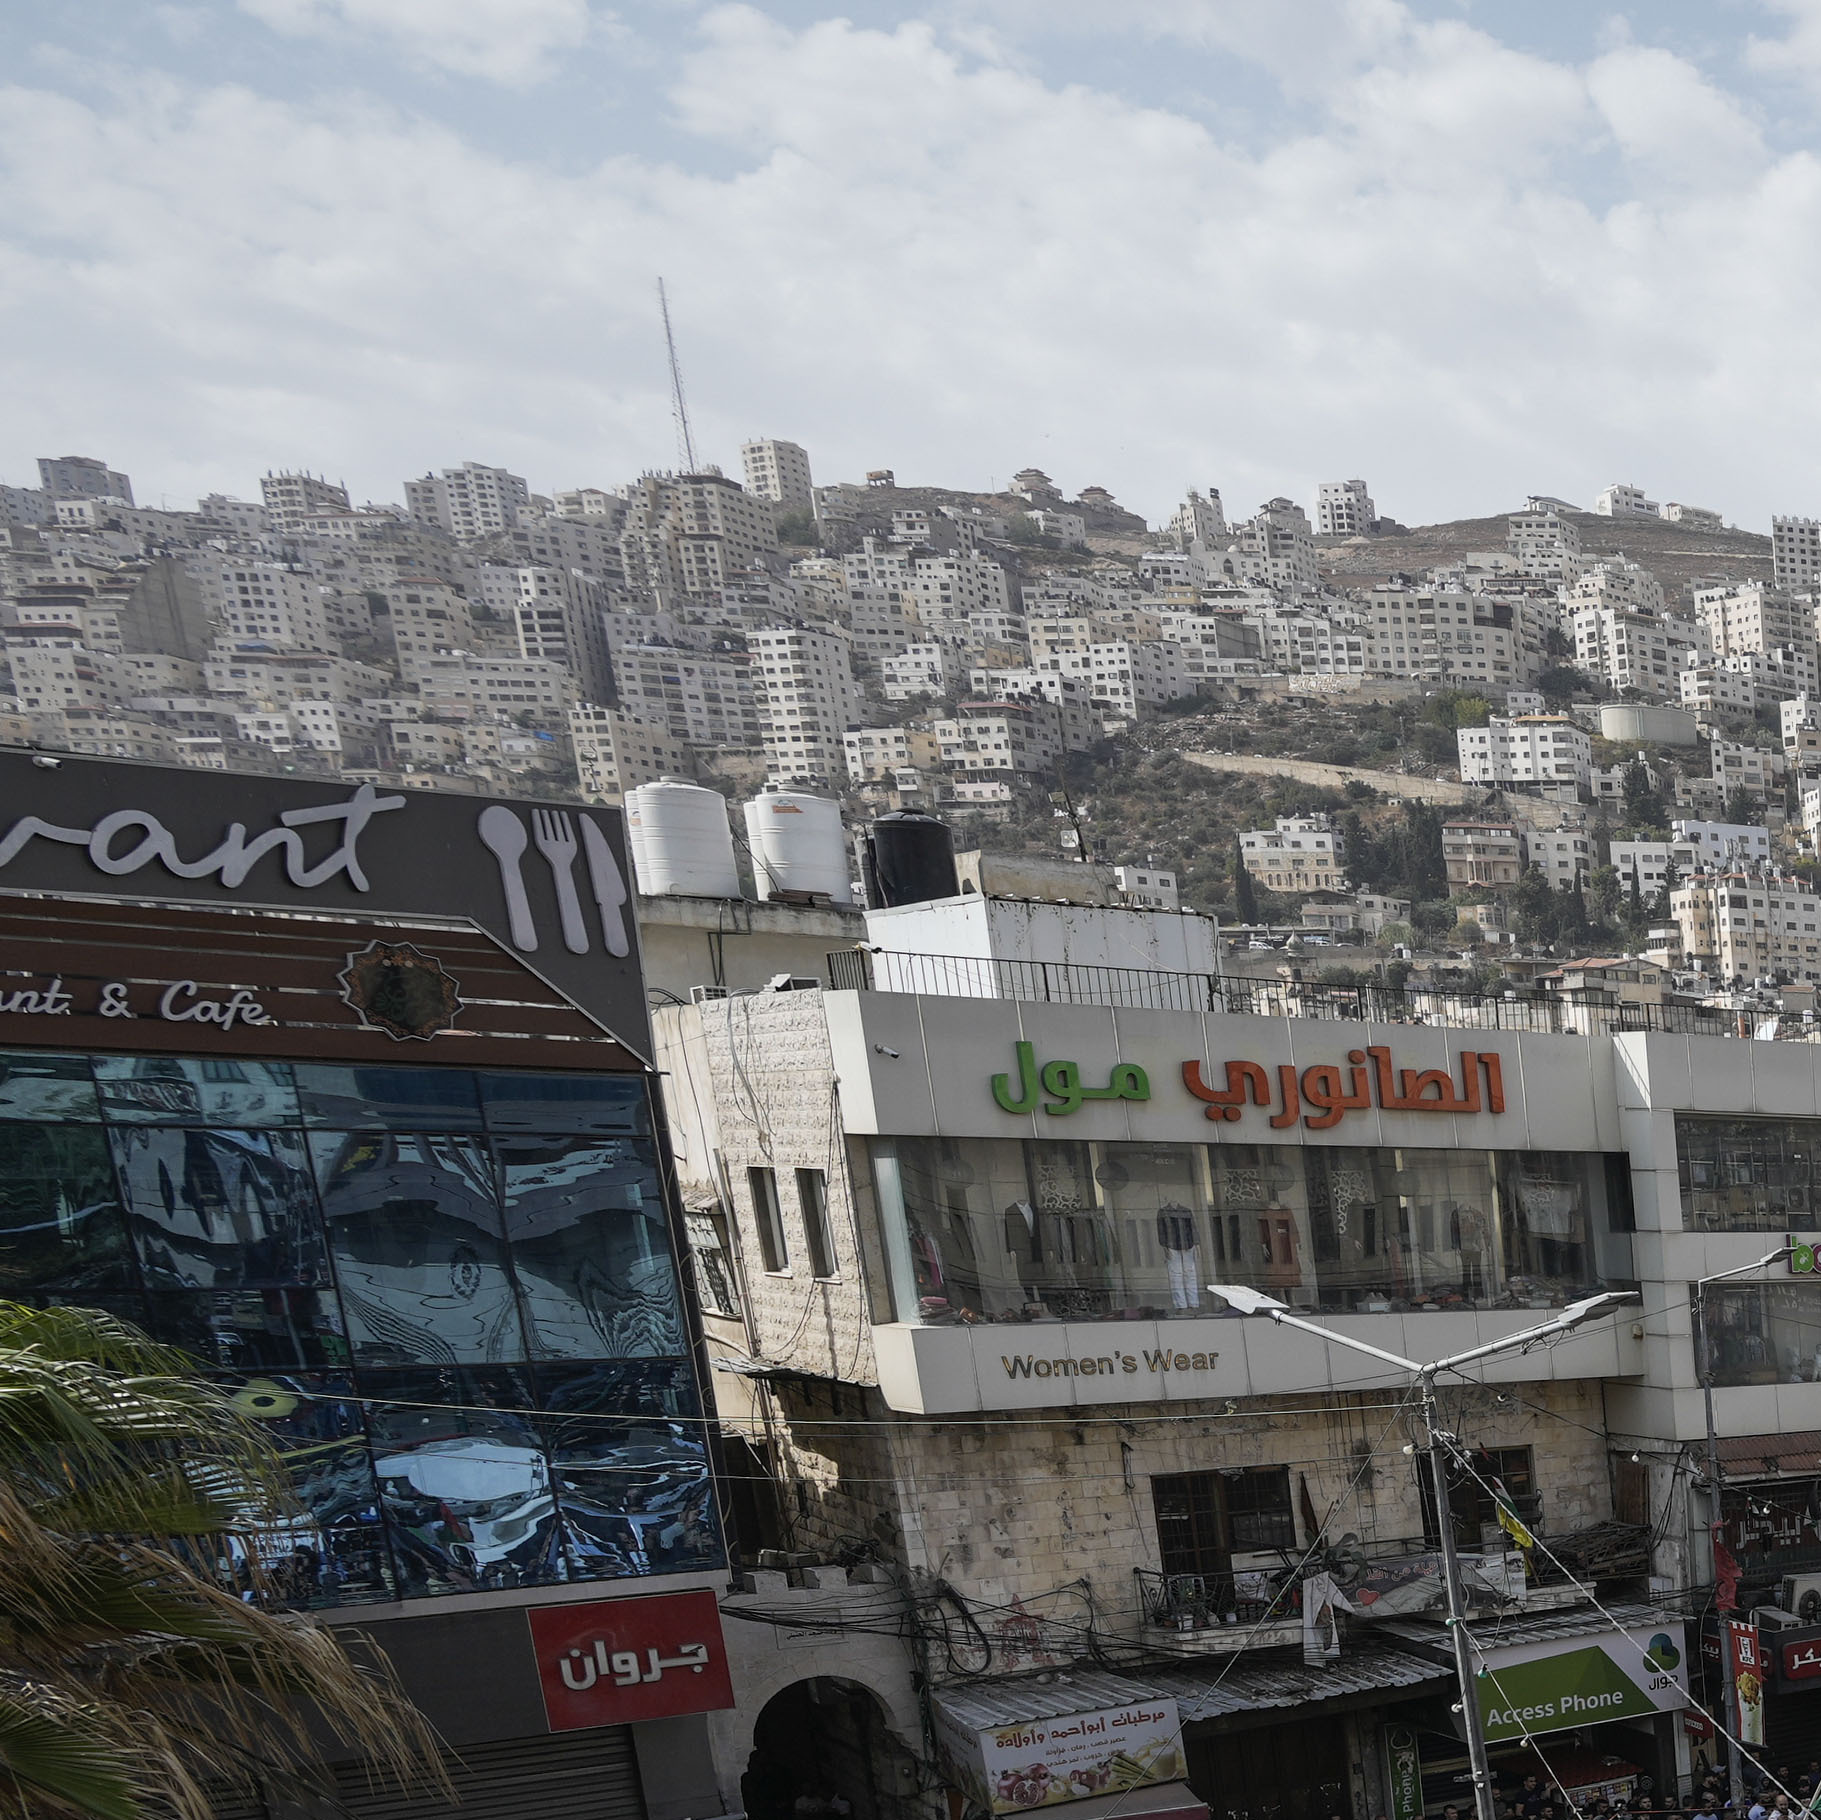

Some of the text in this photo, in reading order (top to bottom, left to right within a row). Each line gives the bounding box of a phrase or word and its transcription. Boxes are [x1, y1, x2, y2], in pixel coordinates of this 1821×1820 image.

[100, 980, 272, 1031] & Cafe
[991, 1041, 1505, 1129] الصانوري مول
[1001, 1349, 1219, 1379] Women's Wear
[558, 1638, 712, 1694] جروان
[1111, 1709, 1166, 1729] مرطبات
[1487, 1689, 1625, 1728] Access Phone
